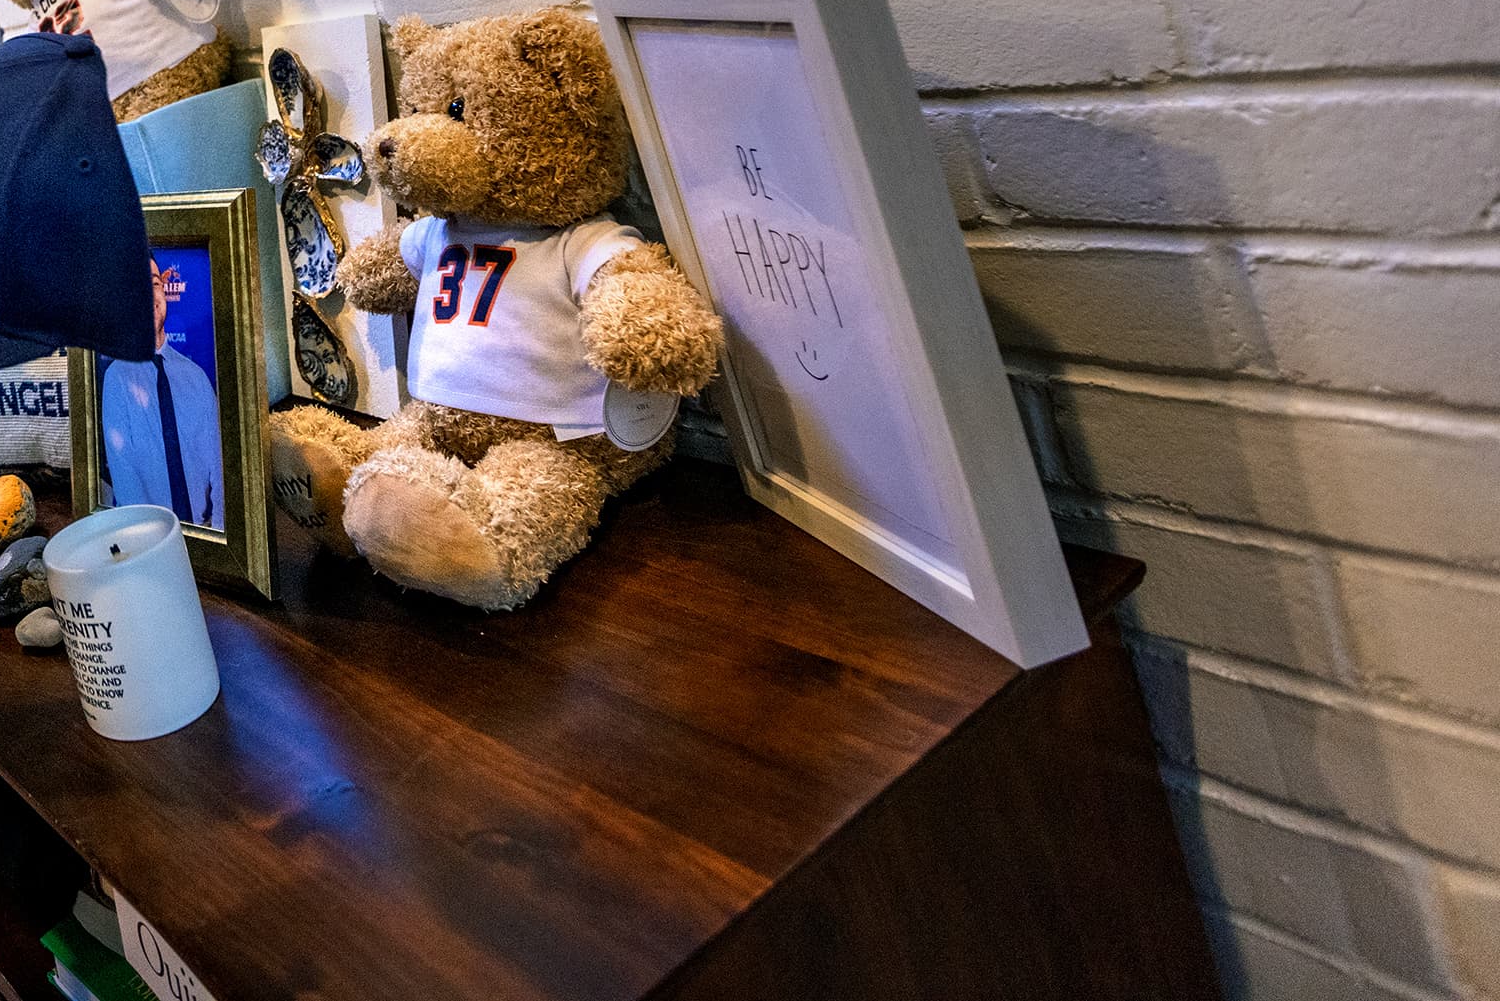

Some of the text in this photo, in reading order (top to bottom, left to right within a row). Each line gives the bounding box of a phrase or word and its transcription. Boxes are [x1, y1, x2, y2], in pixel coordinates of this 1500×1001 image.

[735, 144, 773, 201] BE
[722, 209, 844, 329] HAPPY
[432, 243, 517, 327] 37
[70, 602, 95, 619] ME
[80, 641, 114, 653] THINGS
[88, 664, 127, 675] CHANGE
[101, 677, 123, 688] AND
[95, 688, 125, 699] KNOW
